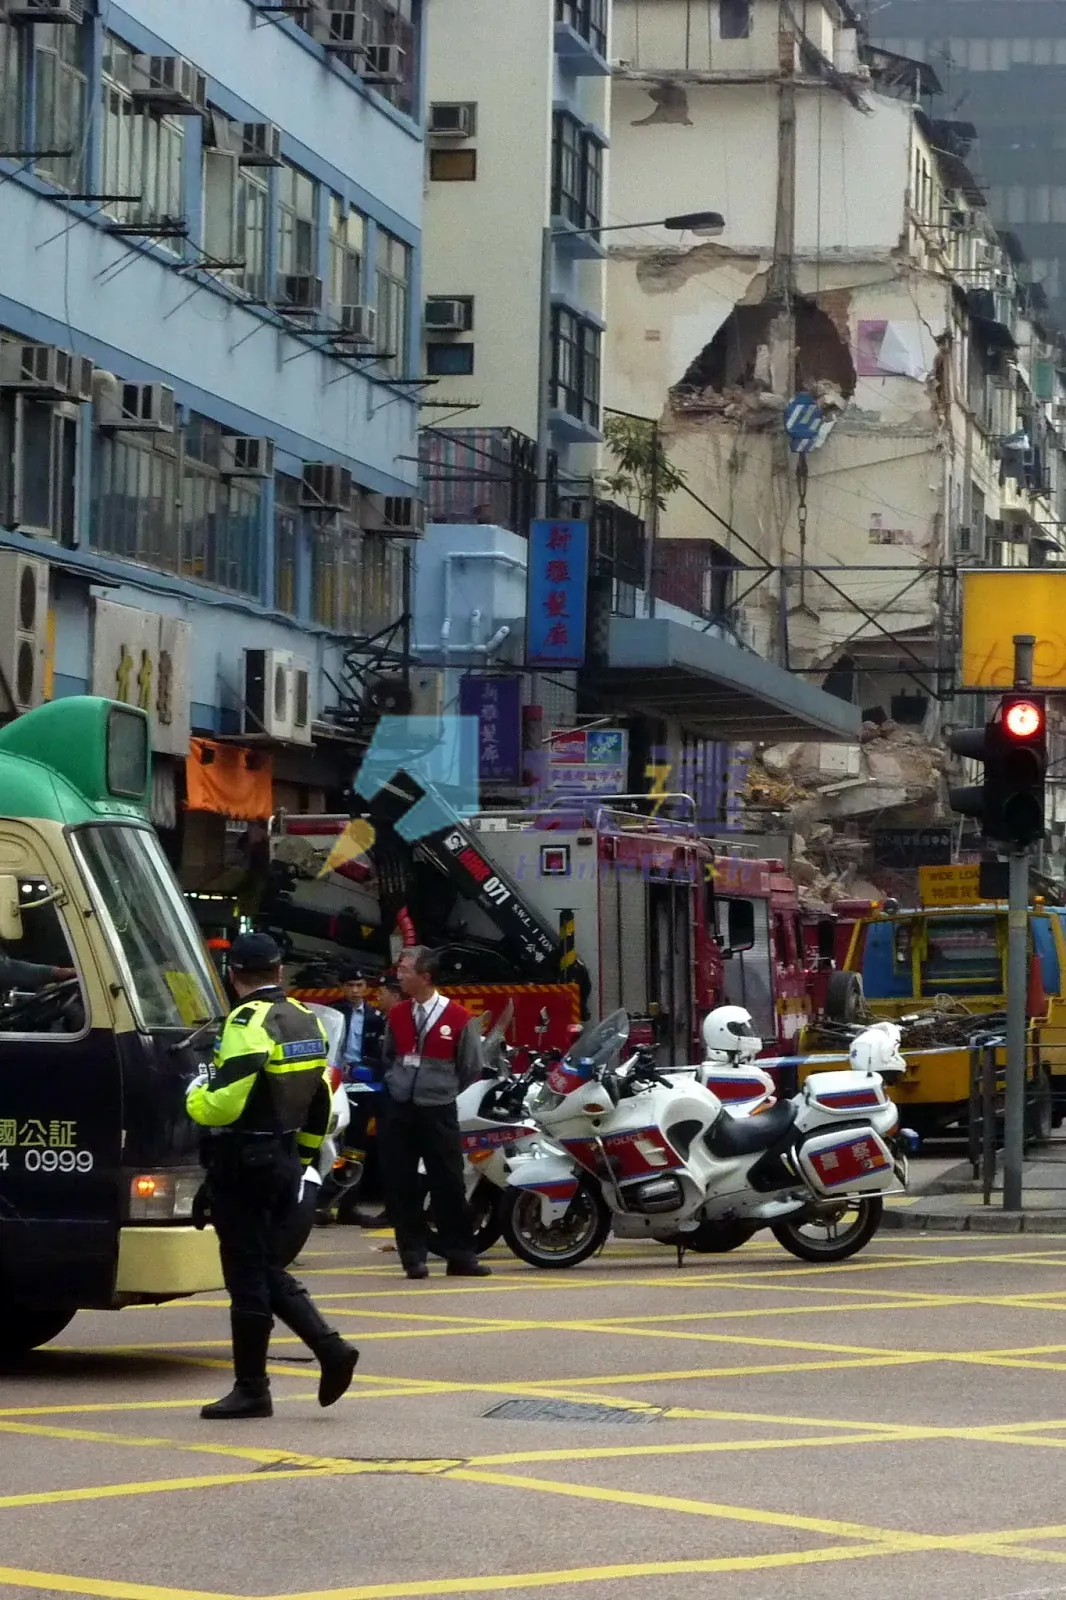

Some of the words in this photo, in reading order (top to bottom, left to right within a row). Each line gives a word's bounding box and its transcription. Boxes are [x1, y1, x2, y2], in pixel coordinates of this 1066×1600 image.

[928, 870, 954, 881] WIDE
[482, 876, 511, 905] 071
[292, 1042, 318, 1055] POLICE
[606, 1132, 645, 1147] POLICE
[25, 1149, 94, 1173] 0999
